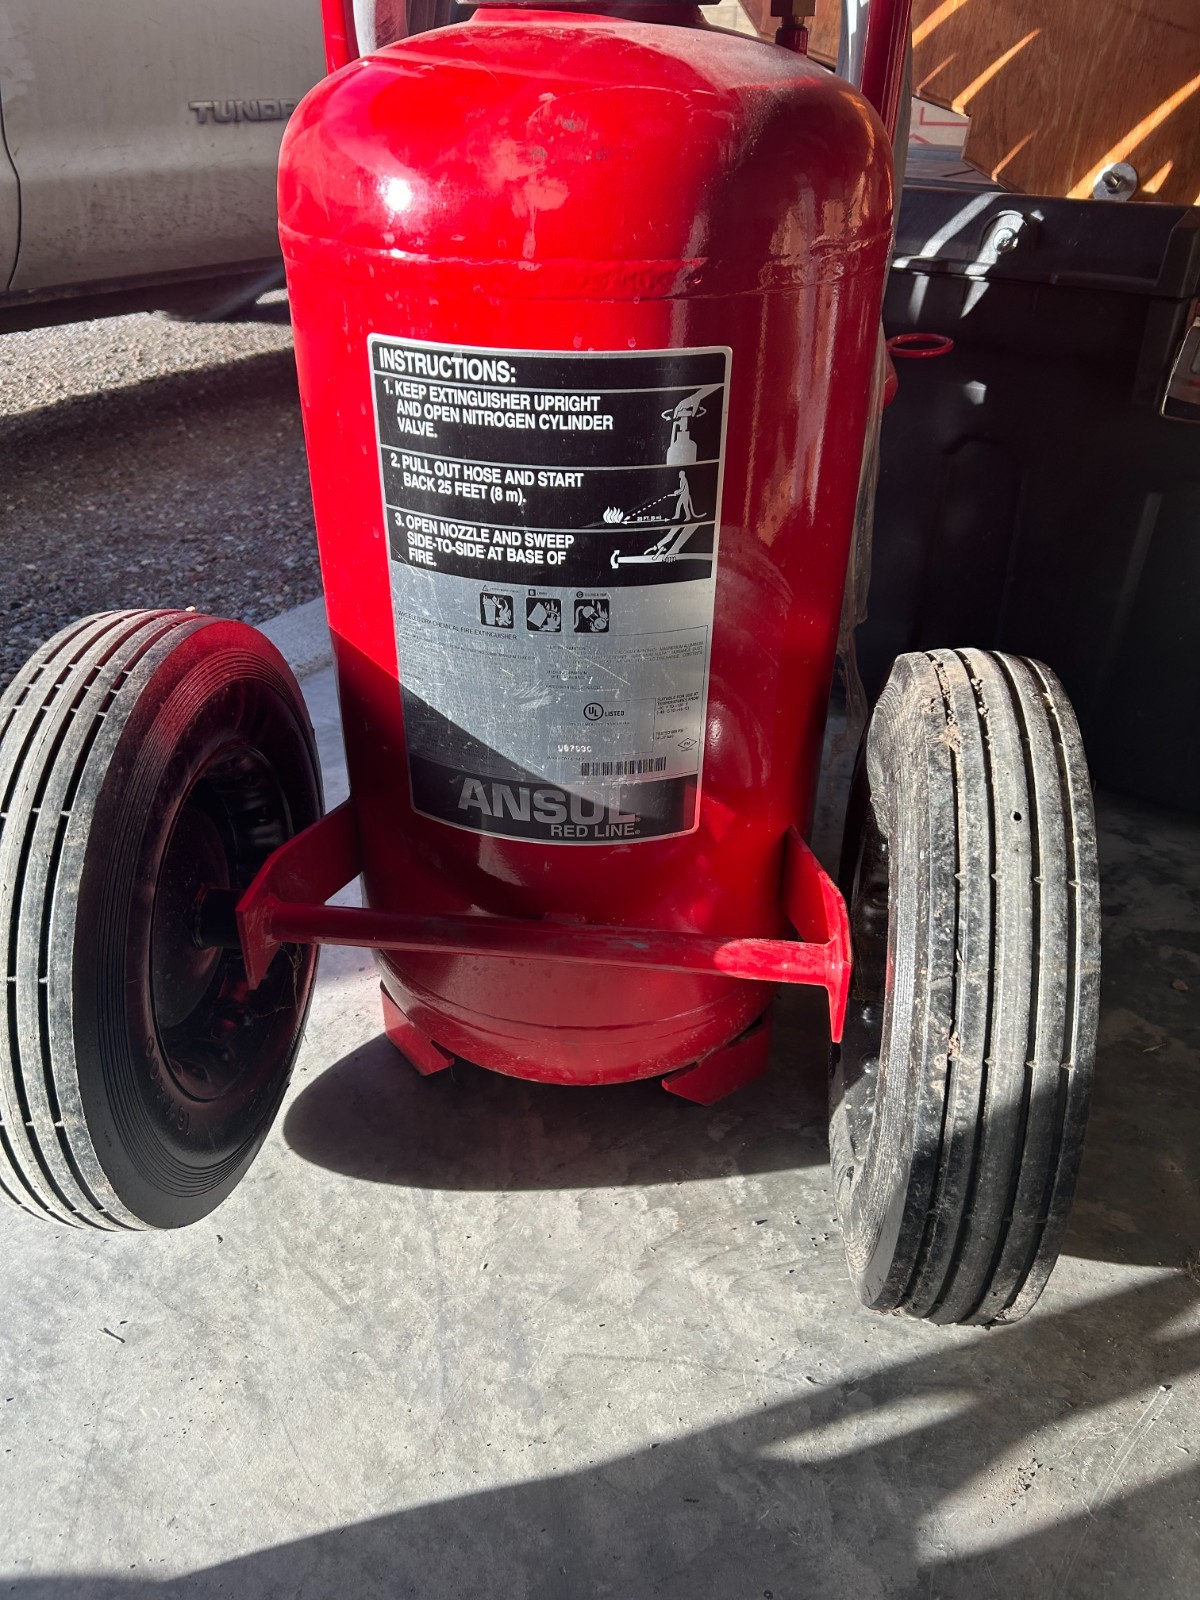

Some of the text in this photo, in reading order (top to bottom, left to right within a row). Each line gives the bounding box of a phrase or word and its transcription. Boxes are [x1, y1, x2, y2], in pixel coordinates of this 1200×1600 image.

[379, 347, 516, 383] INSTRUCTIONS:
[383, 379, 601, 412] 1. KEEP EXTINGUISHER UPRIGHT
[397, 398, 614, 431] AND OPEN NITROGEN CYLINDER
[397, 416, 438, 438] VALVE.
[391, 453, 584, 487] 2. PULL OUT HOSE AND START
[403, 471, 527, 504] BACK 25 FEET (8 m).
[395, 512, 575, 549] 3. OPEN NOZZLE AND SWEEP
[407, 531, 567, 566] SIDE-TO-SIDE AT BASE OF
[408, 548, 437, 567] FIRE.
[551, 823, 590, 838] RED
